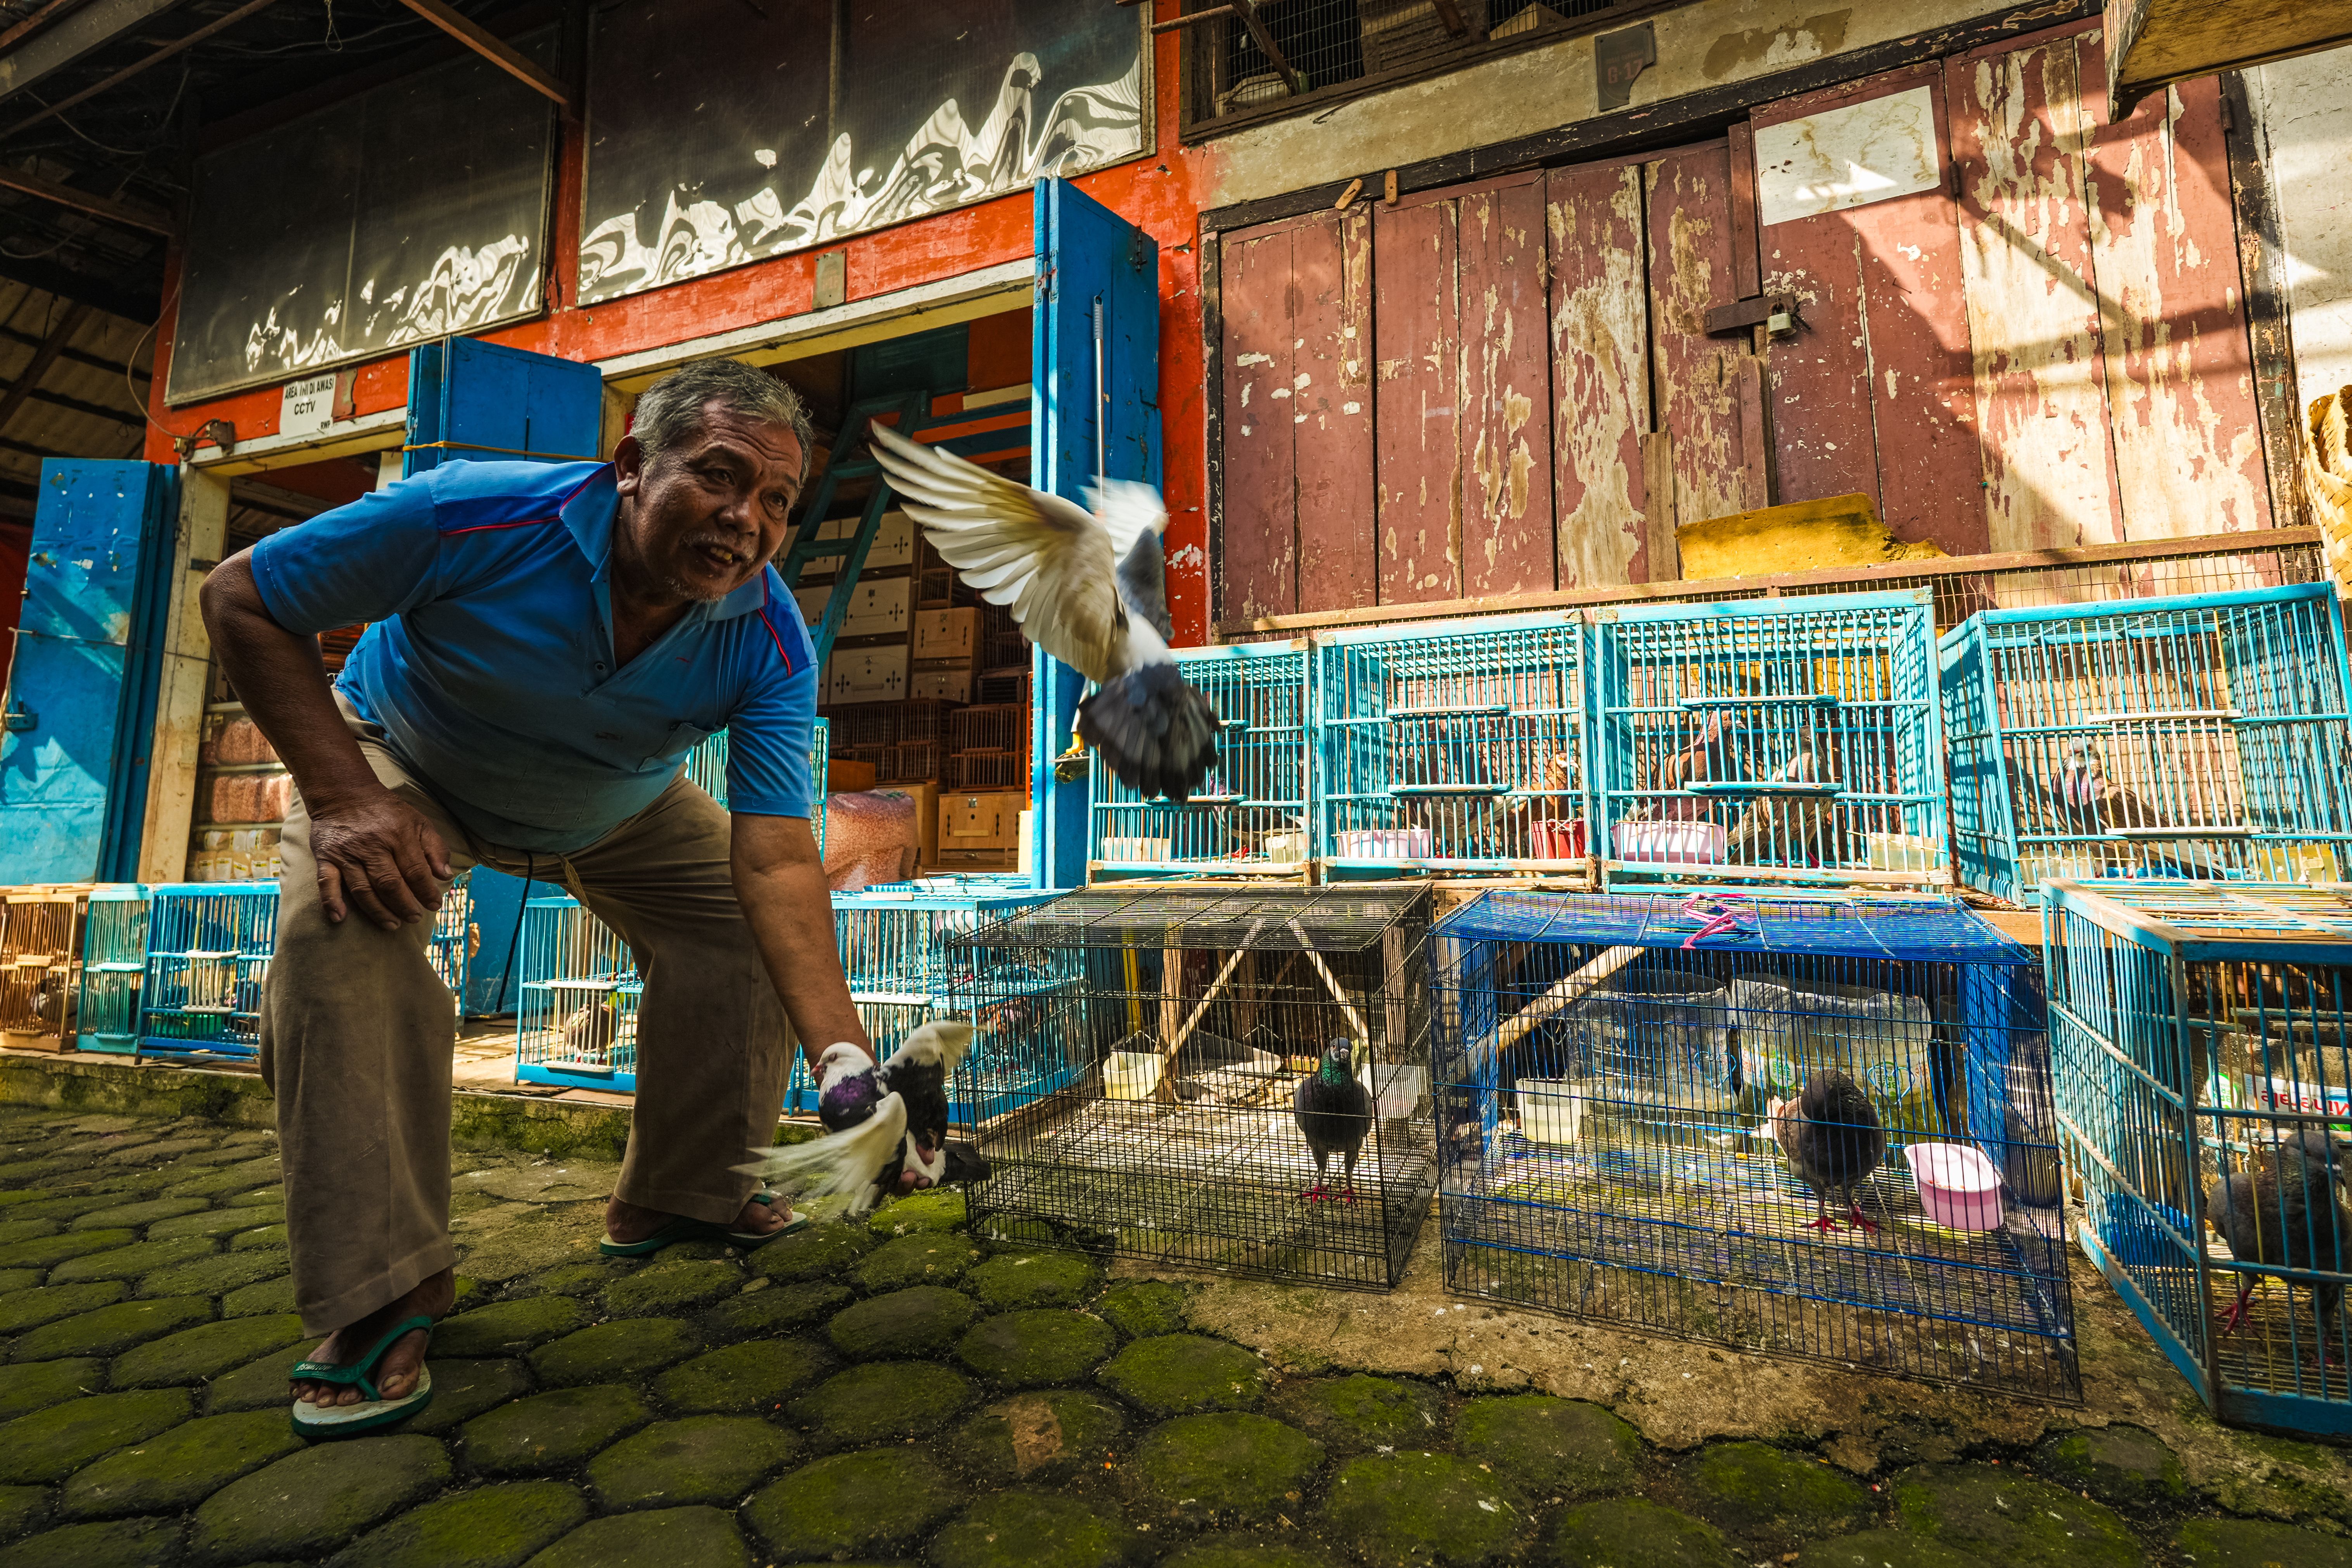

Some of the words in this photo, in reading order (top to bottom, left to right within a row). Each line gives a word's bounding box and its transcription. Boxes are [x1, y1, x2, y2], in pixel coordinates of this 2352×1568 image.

[284, 386, 297, 400] AREA
[299, 384, 308, 396] INI
[310, 382, 315, 394] DI
[316, 377, 334, 392] AWASI
[294, 400, 316, 415] CCTV
